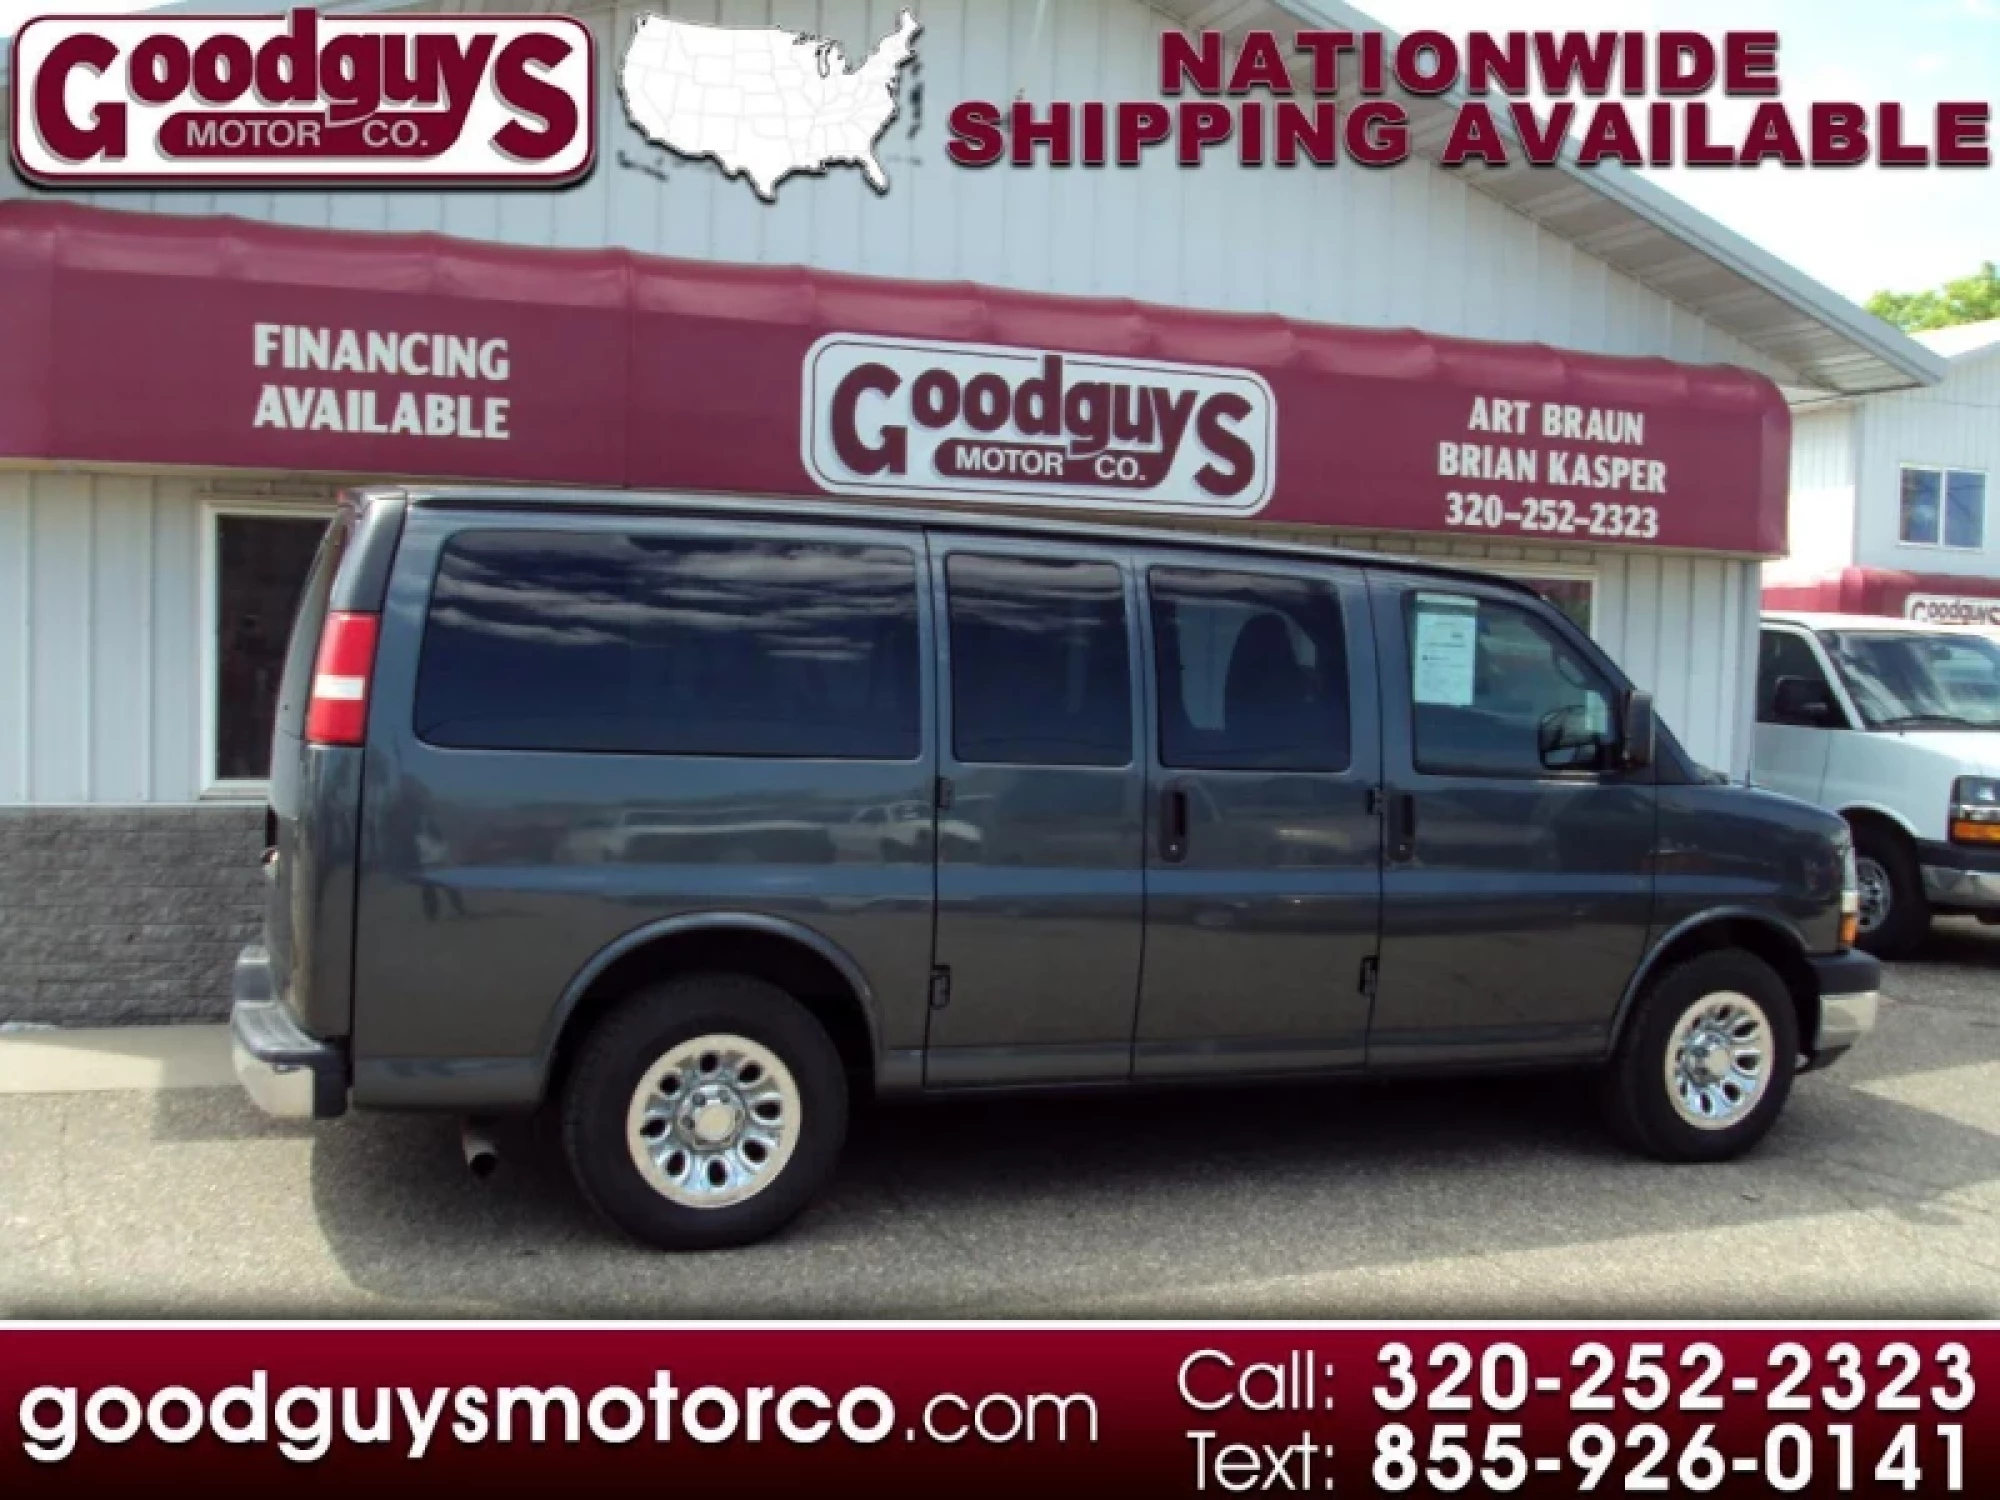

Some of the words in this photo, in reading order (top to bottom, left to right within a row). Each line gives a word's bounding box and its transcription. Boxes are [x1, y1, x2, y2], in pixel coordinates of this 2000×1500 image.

[253, 323, 510, 381] FINANCING
[253, 385, 510, 439] AVAILABLE
[1468, 396, 1531, 435] ART
[1541, 402, 1644, 446] BRAUN
[955, 444, 1063, 477] MOTOR
[1095, 454, 1147, 482] CO.
[1437, 441, 1536, 483] BRIAN
[1548, 450, 1667, 494] KASPER
[1446, 491, 1659, 539] 320-252-2323
